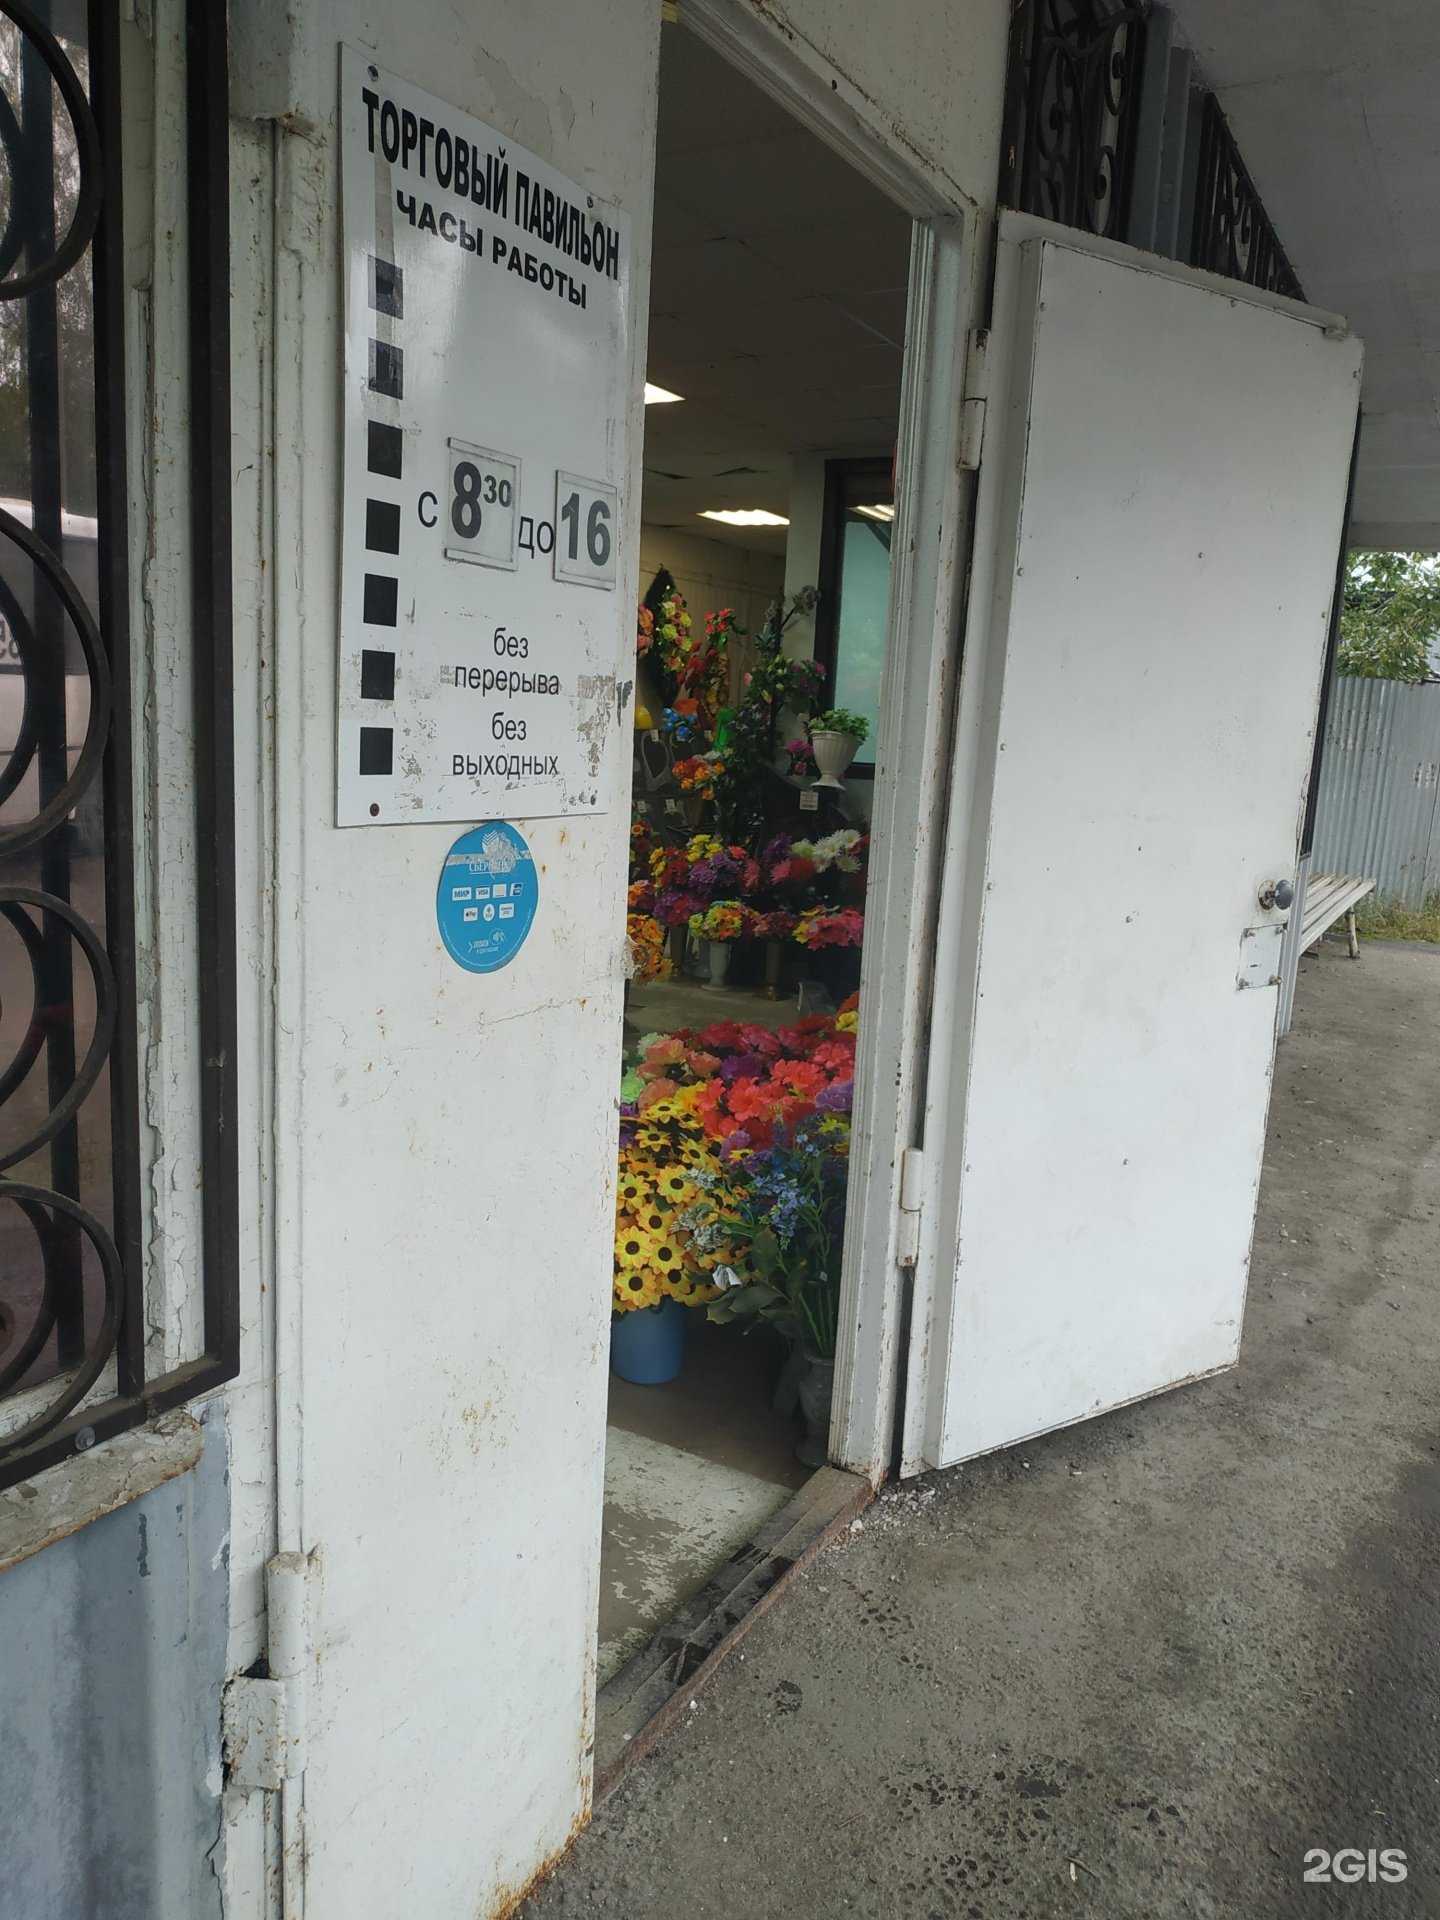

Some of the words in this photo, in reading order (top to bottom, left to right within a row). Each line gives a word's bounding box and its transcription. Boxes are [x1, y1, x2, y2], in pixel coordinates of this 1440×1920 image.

[362, 86, 509, 219] ТОРГОВЫЙ
[514, 170, 620, 280] ПАВИЛЬОН
[396, 190, 483, 257] ЧАСЫ
[492, 236, 587, 309] РАБОТЫ
[518, 516, 554, 559] до
[561, 492, 611, 567] 16
[493, 627, 529, 658] без
[454, 666, 560, 699] перерыва
[491, 712, 527, 740] без
[452, 754, 559, 780] выходных
